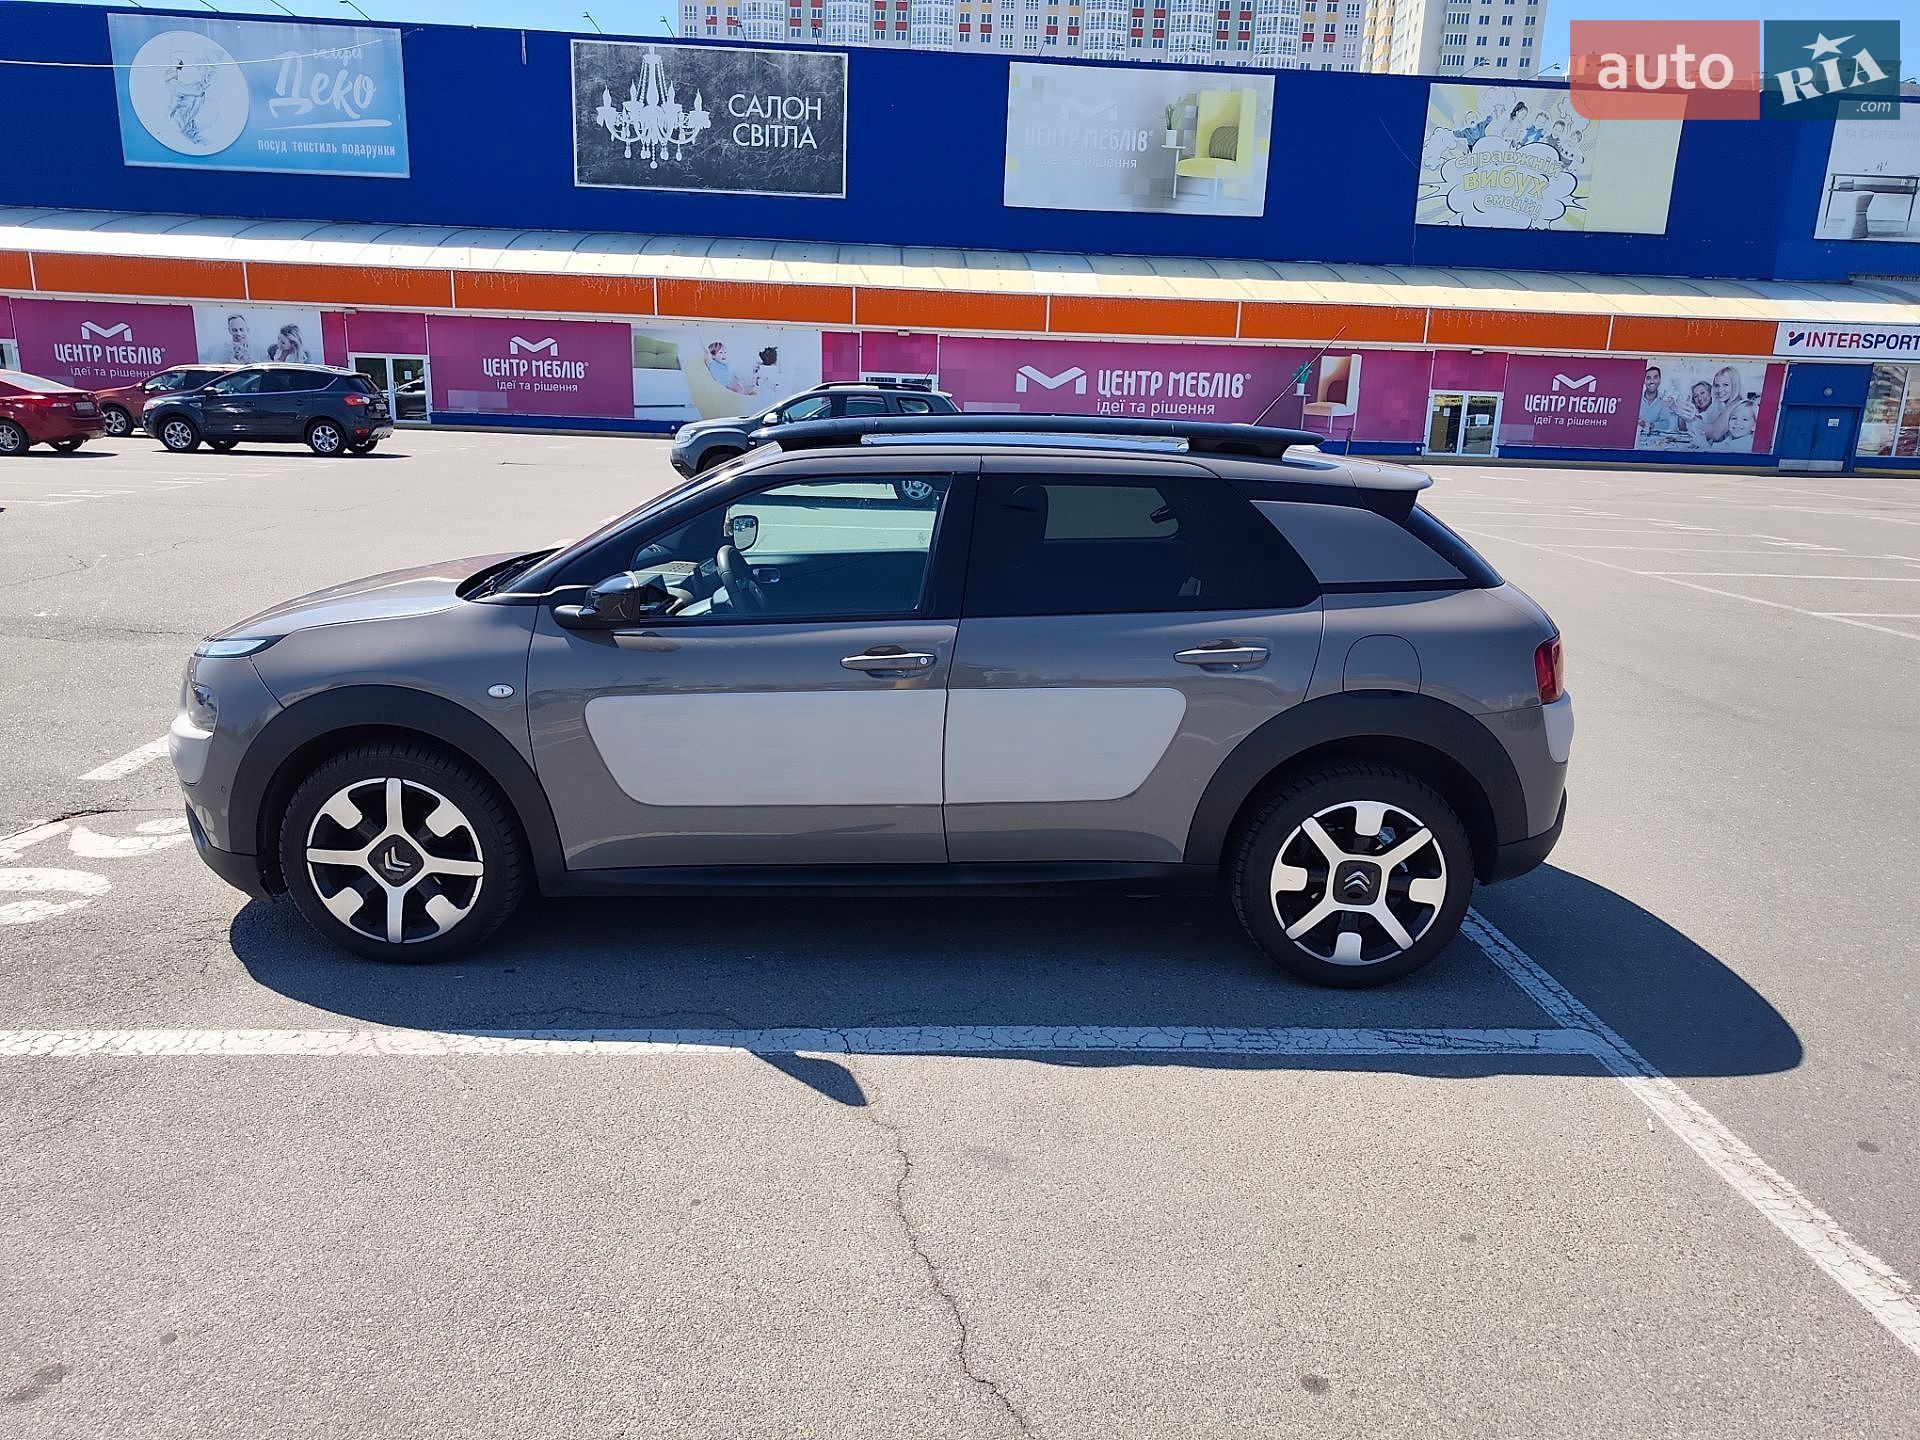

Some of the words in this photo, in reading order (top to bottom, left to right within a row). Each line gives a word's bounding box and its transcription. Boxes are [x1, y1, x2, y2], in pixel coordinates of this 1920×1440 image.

[269, 50, 377, 119] Деко
[728, 93, 822, 121] САЛОН
[732, 122, 818, 149] СВІТЛА
[1025, 125, 1080, 150] ЦЕНТР
[257, 139, 288, 154] посуд
[292, 140, 338, 154] текстиль
[342, 142, 396, 158] подарунки
[1455, 150, 1562, 178] справжній
[1463, 165, 1550, 199] вибух
[1805, 331, 1920, 350] INTERSPORT
[54, 343, 103, 363] ЦЕНТР
[105, 345, 162, 365] МЕБЛІВ
[70, 365, 91, 377] ідеї
[94, 367, 106, 377] та
[483, 358, 528, 377] ЦЕНТР
[532, 359, 585, 379] МЕБЛІВ
[496, 379, 517, 391] ідеї
[519, 382, 531, 390] та
[534, 381, 578, 392] рішення
[1098, 369, 1163, 398] ЦЕНТР
[1168, 370, 1244, 398] МЕБЛІВ
[1096, 399, 1126, 415] ідеї
[1130, 402, 1145, 413] та
[1151, 401, 1215, 417] рішення
[1524, 394, 1566, 413] ЦЕНТР
[1568, 396, 1617, 414] МЕБЛІВ
[1533, 415, 1552, 425] ідеї
[1554, 417, 1564, 425] та
[1567, 416, 1608, 427] рішення
